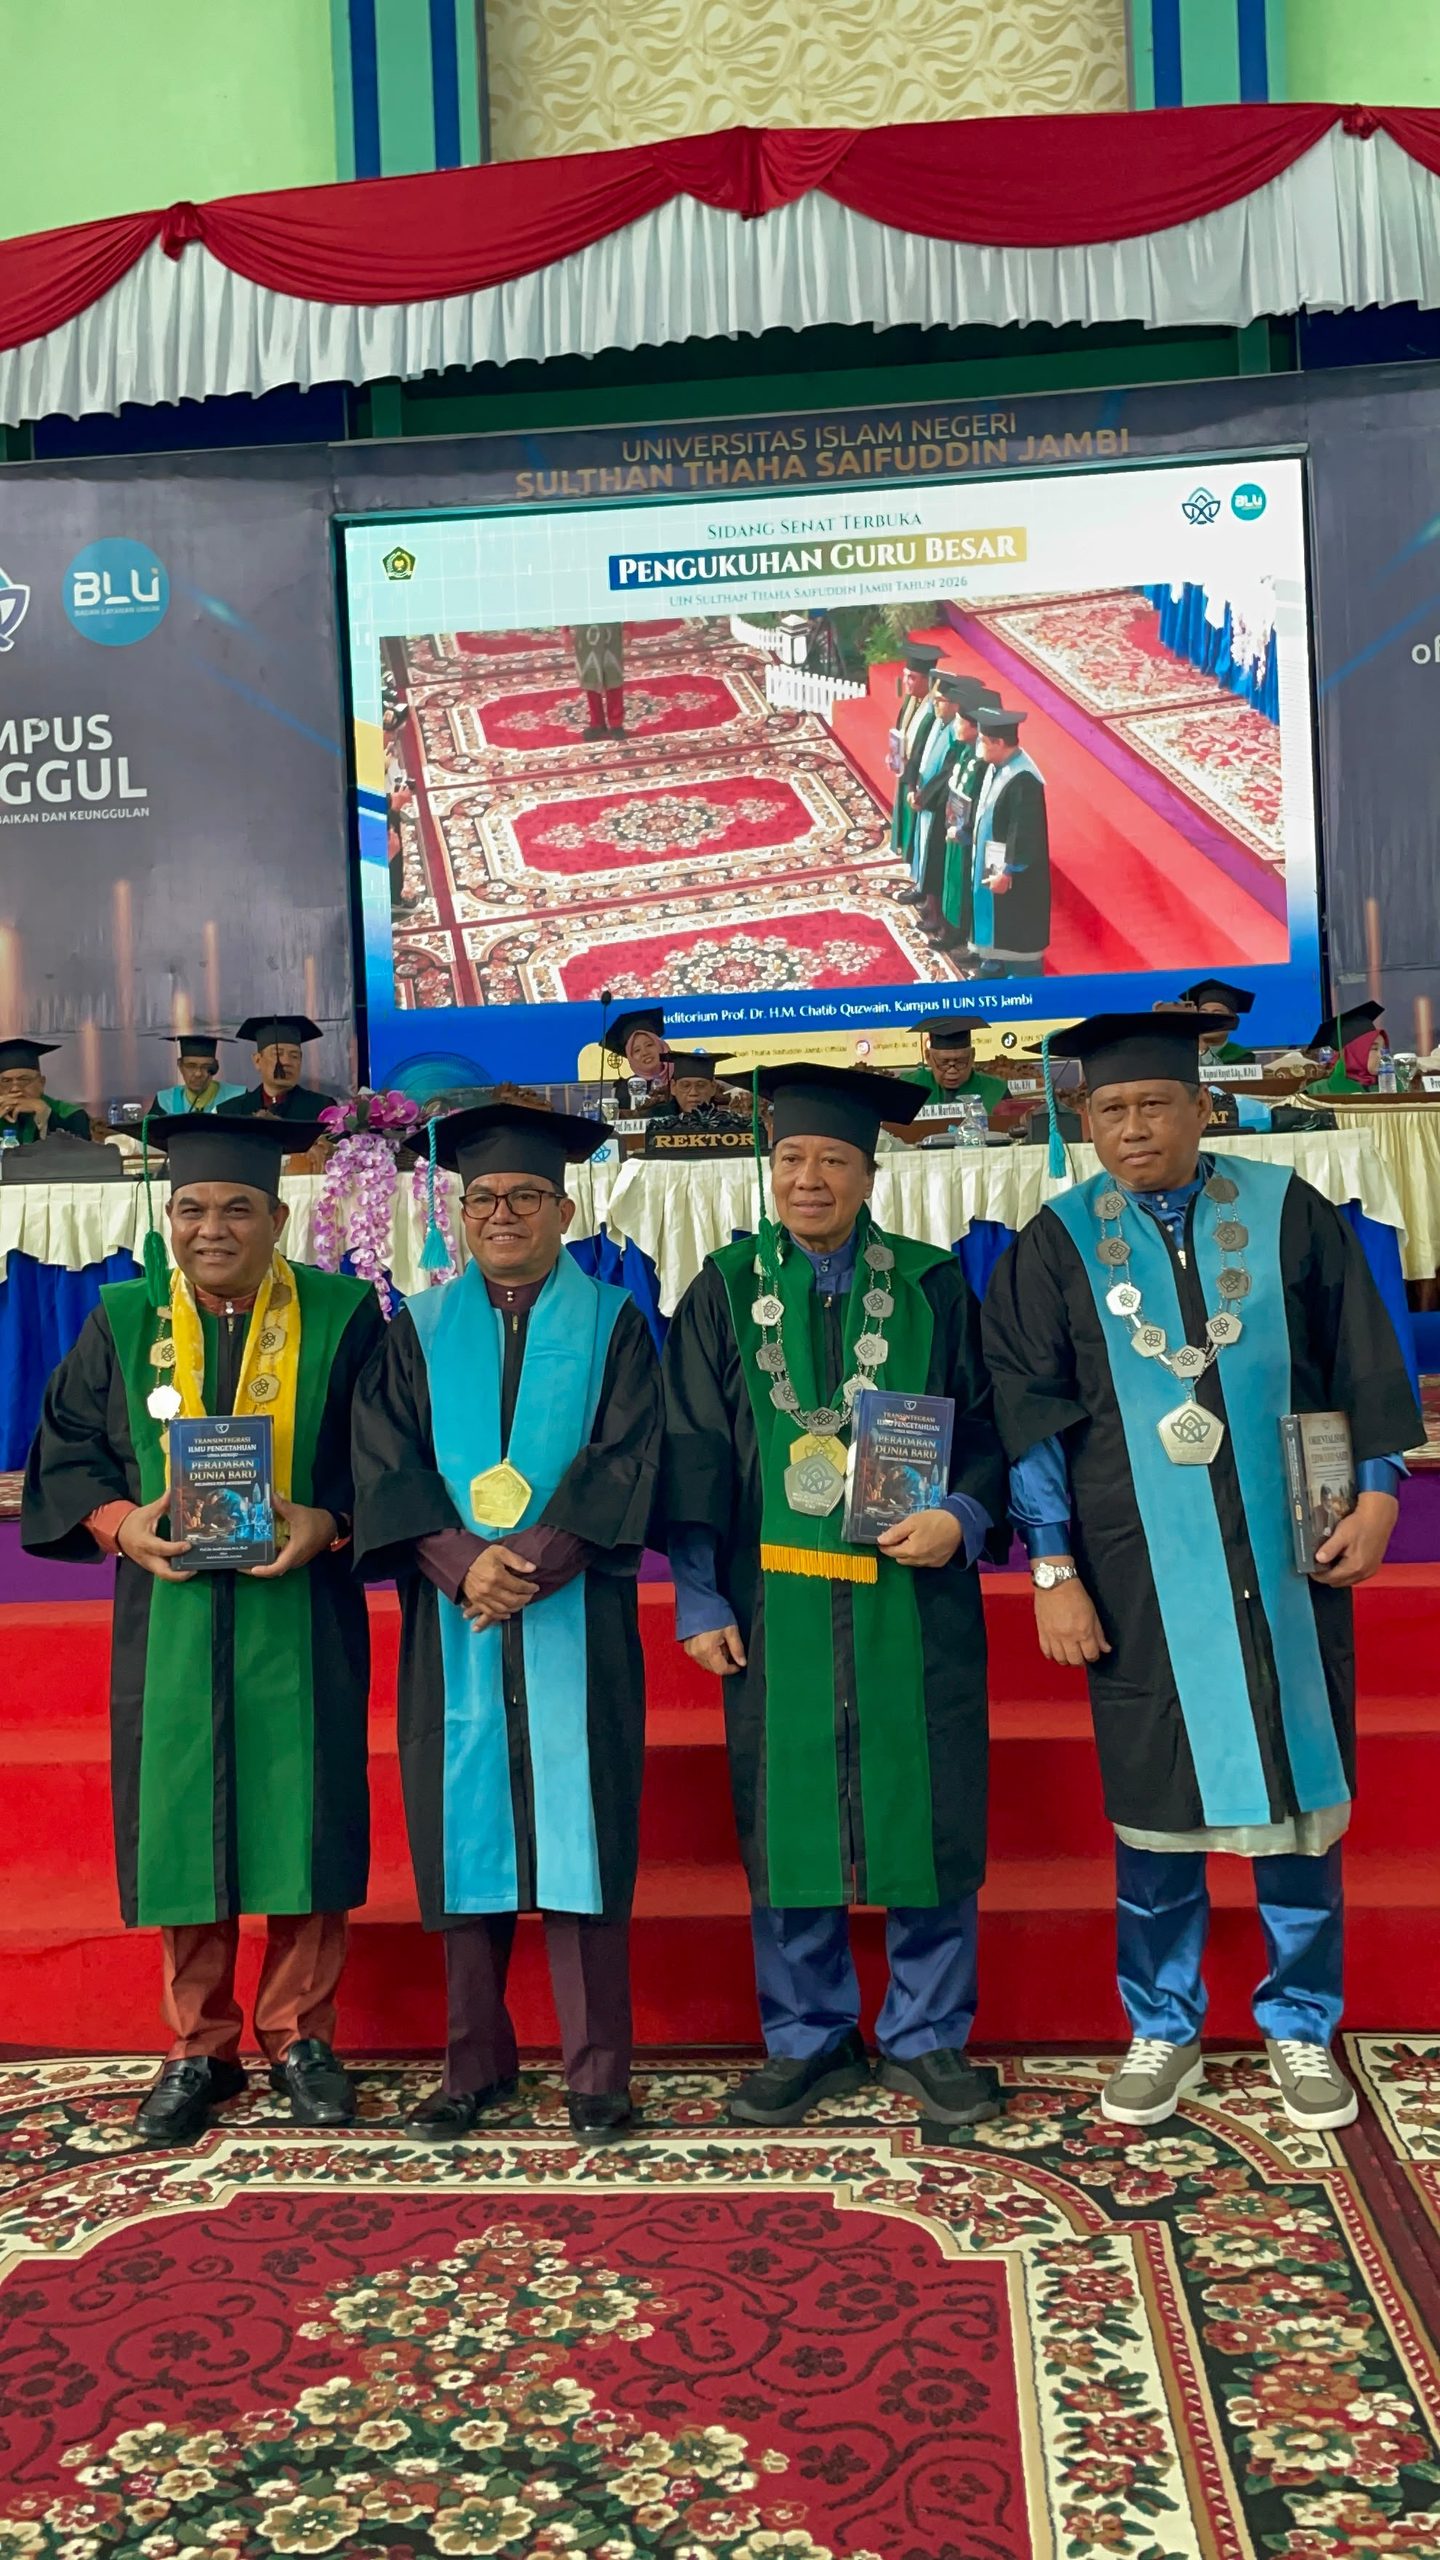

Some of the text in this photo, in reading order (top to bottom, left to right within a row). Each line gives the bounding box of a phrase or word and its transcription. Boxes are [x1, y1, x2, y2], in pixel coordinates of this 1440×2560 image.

[622, 412, 1016, 462] UNIVERSITAS ISLAM NEGERI
[515, 428, 1130, 498] SULTHAN THAHA SAIFUDDIN JAMBI
[707, 512, 923, 540] SIDANG SENAT TERBUKA
[618, 535, 1017, 585] PENGUKUHAN GURU BESAR
[73, 568, 160, 607] BLU
[669, 596, 693, 607] UIN
[696, 593, 748, 605] SULTHAN
[859, 582, 893, 596] JAMBI
[896, 579, 936, 592] TAHUN
[939, 576, 968, 589] 2026
[0, 713, 113, 755] MPUS
[0, 756, 148, 805] GGUL
[41, 811, 67, 823] DAN
[69, 807, 150, 821] KEUNGGULAN
[663, 1010, 718, 1024] uditorium
[721, 1008, 748, 1021] Prof.
[750, 1008, 767, 1019] Dr.
[769, 1006, 797, 1018] H.M.
[800, 1004, 837, 1016] Chatib
[895, 998, 940, 1014] Kampus
[953, 996, 975, 1009] UIN
[978, 995, 998, 1008] STS
[1000, 993, 1033, 1008] Jambi
[655, 1132, 756, 1148] REKTOR
[207, 1444, 257, 1452] PENGETAHUAN
[875, 1444, 938, 1460] DUNIA BARU
[878, 1434, 937, 1448] PERADABAN
[189, 1470, 257, 1481] DUNIA BARU
[191, 1460, 254, 1470] PERADABAN
